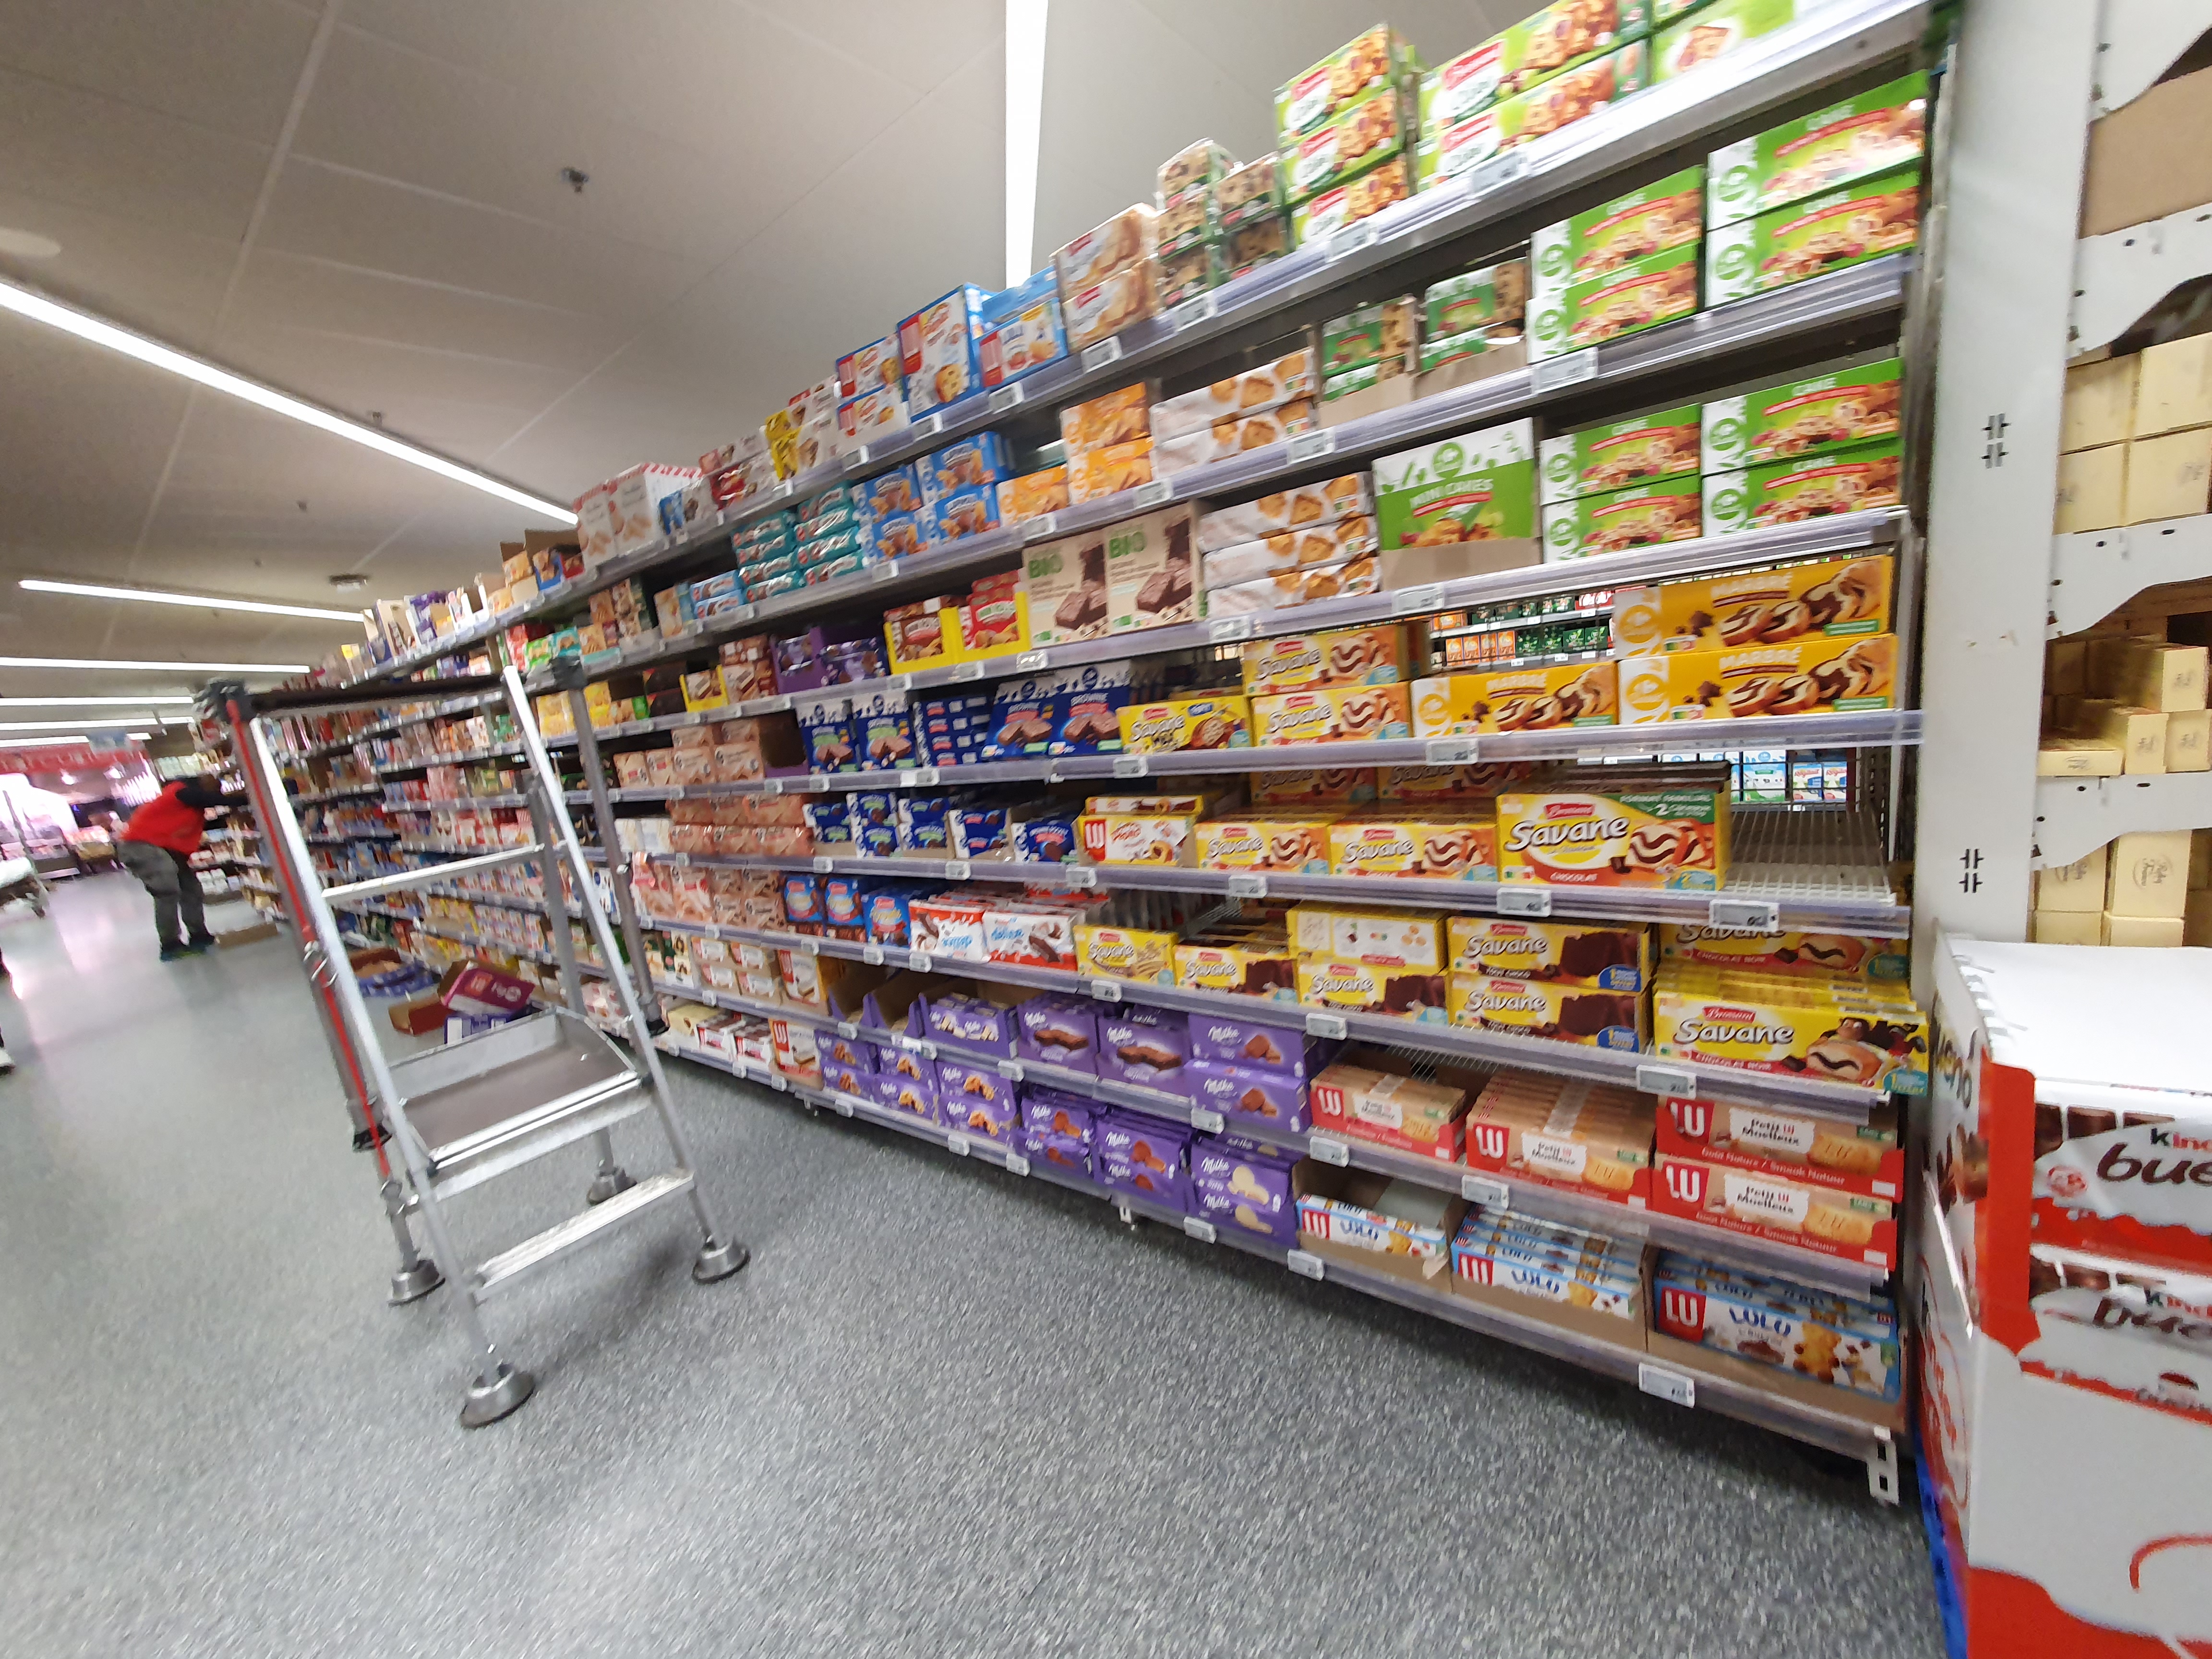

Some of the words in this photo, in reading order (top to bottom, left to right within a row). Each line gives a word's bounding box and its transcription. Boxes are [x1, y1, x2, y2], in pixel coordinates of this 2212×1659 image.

[1108, 532, 1146, 558] BIO
[1027, 553, 1063, 579] BIO
[1257, 648, 1320, 679] Savane
[1130, 715, 1185, 741] Savane
[1268, 703, 1332, 731] Savane
[1656, 803, 1668, 816] 2
[1505, 817, 1630, 852] Savane
[1207, 837, 1263, 858] Savane
[1344, 840, 1414, 864] Savane
[1463, 935, 1548, 958] Savane
[1184, 960, 1237, 977] Savane
[1311, 974, 1374, 996] Savane
[1464, 990, 1546, 1012] Savane
[1106, 1027, 1133, 1045] Milka
[1208, 1026, 1239, 1042] Milka
[1674, 1018, 1795, 1045] Savane
[1203, 1078, 1235, 1094] Milka
[1669, 1102, 1705, 1137] LU
[1106, 1131, 1130, 1146] Milka
[1202, 1157, 1229, 1173] Milka
[1666, 1165, 1700, 1202] LU
[1203, 1193, 1231, 1208] Milka
[1665, 1290, 1698, 1327] LU
[1729, 1307, 1791, 1337] LULU
